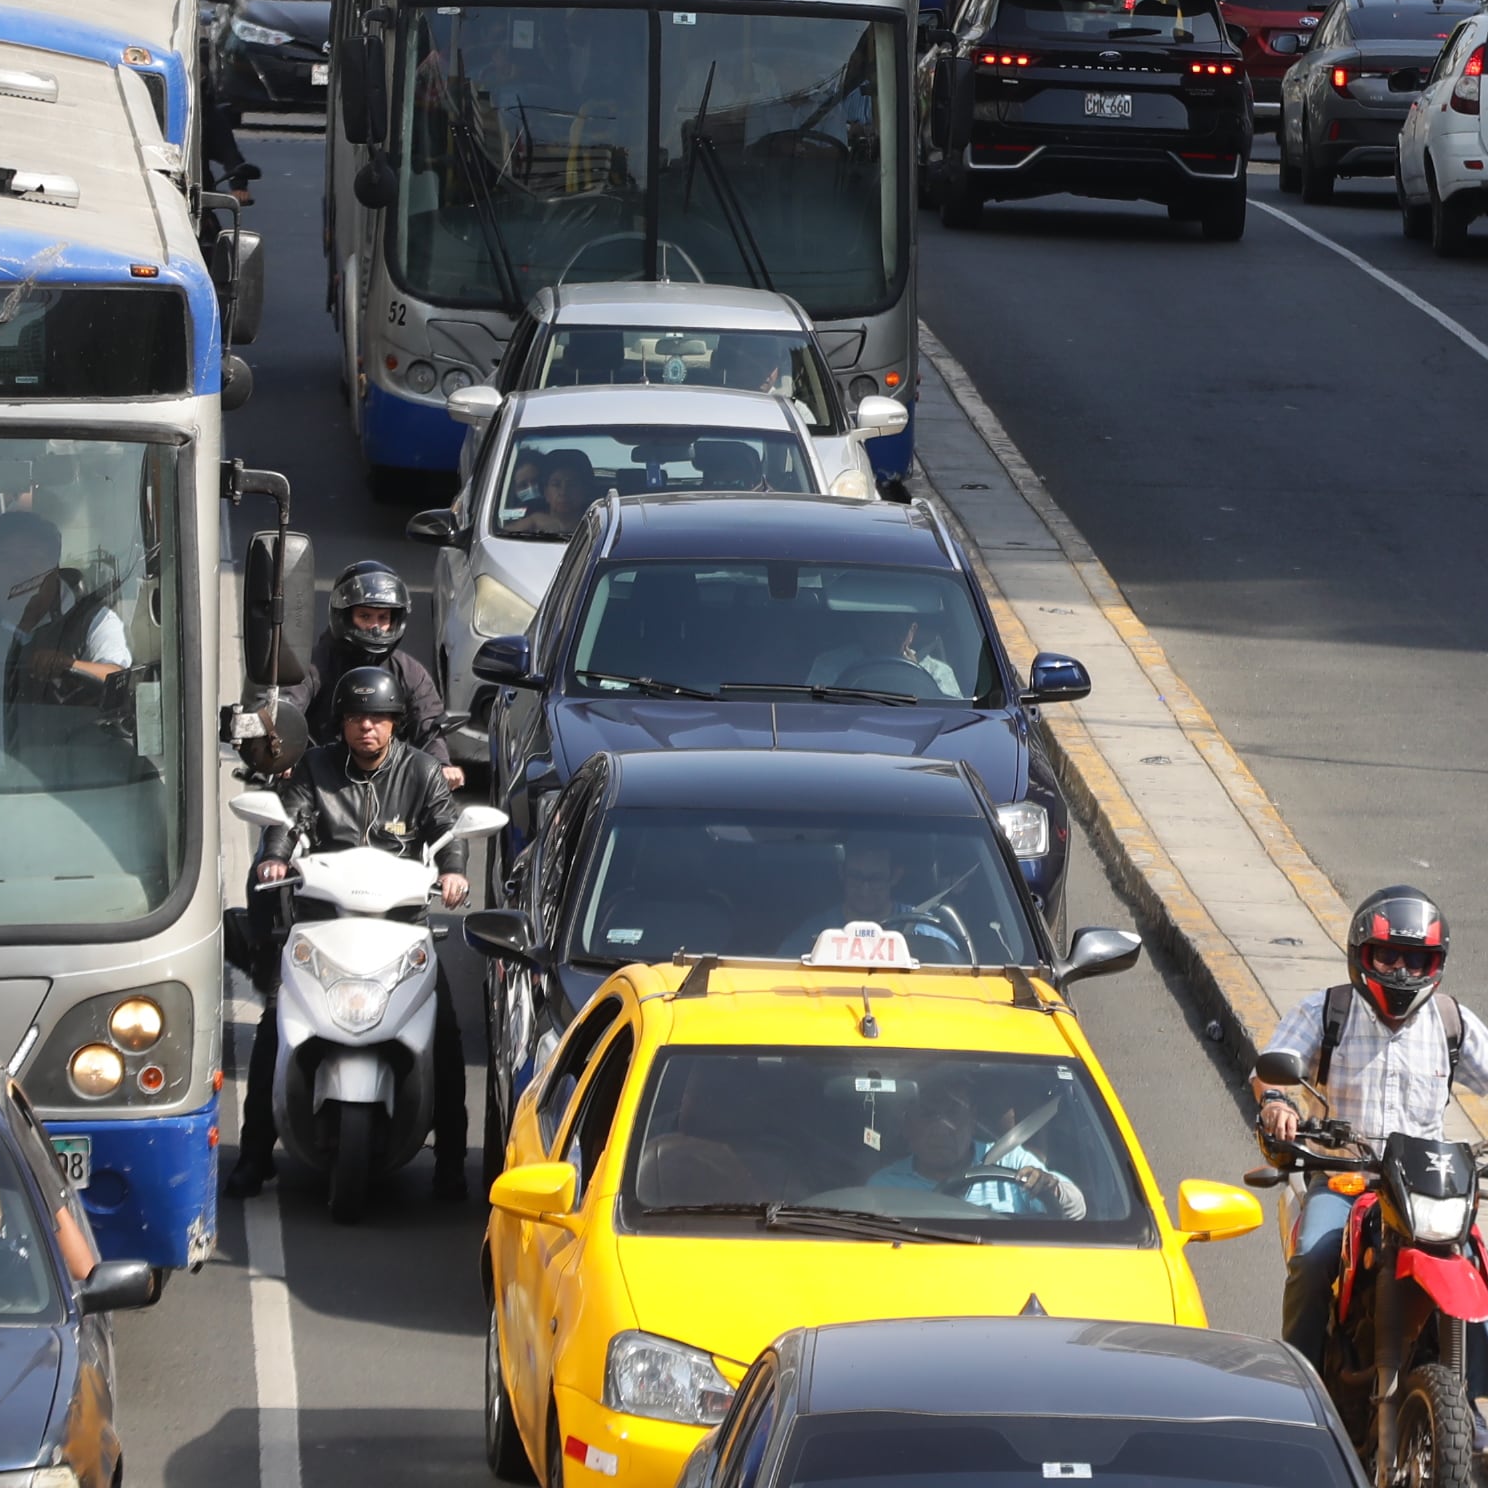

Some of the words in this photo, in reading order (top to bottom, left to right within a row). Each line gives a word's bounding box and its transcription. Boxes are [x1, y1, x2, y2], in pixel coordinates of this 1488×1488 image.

[1085, 98, 1131, 115] CMK-660
[388, 300, 407, 327] 52
[855, 929, 875, 938] LIBRE
[831, 937, 895, 961] TAXI
